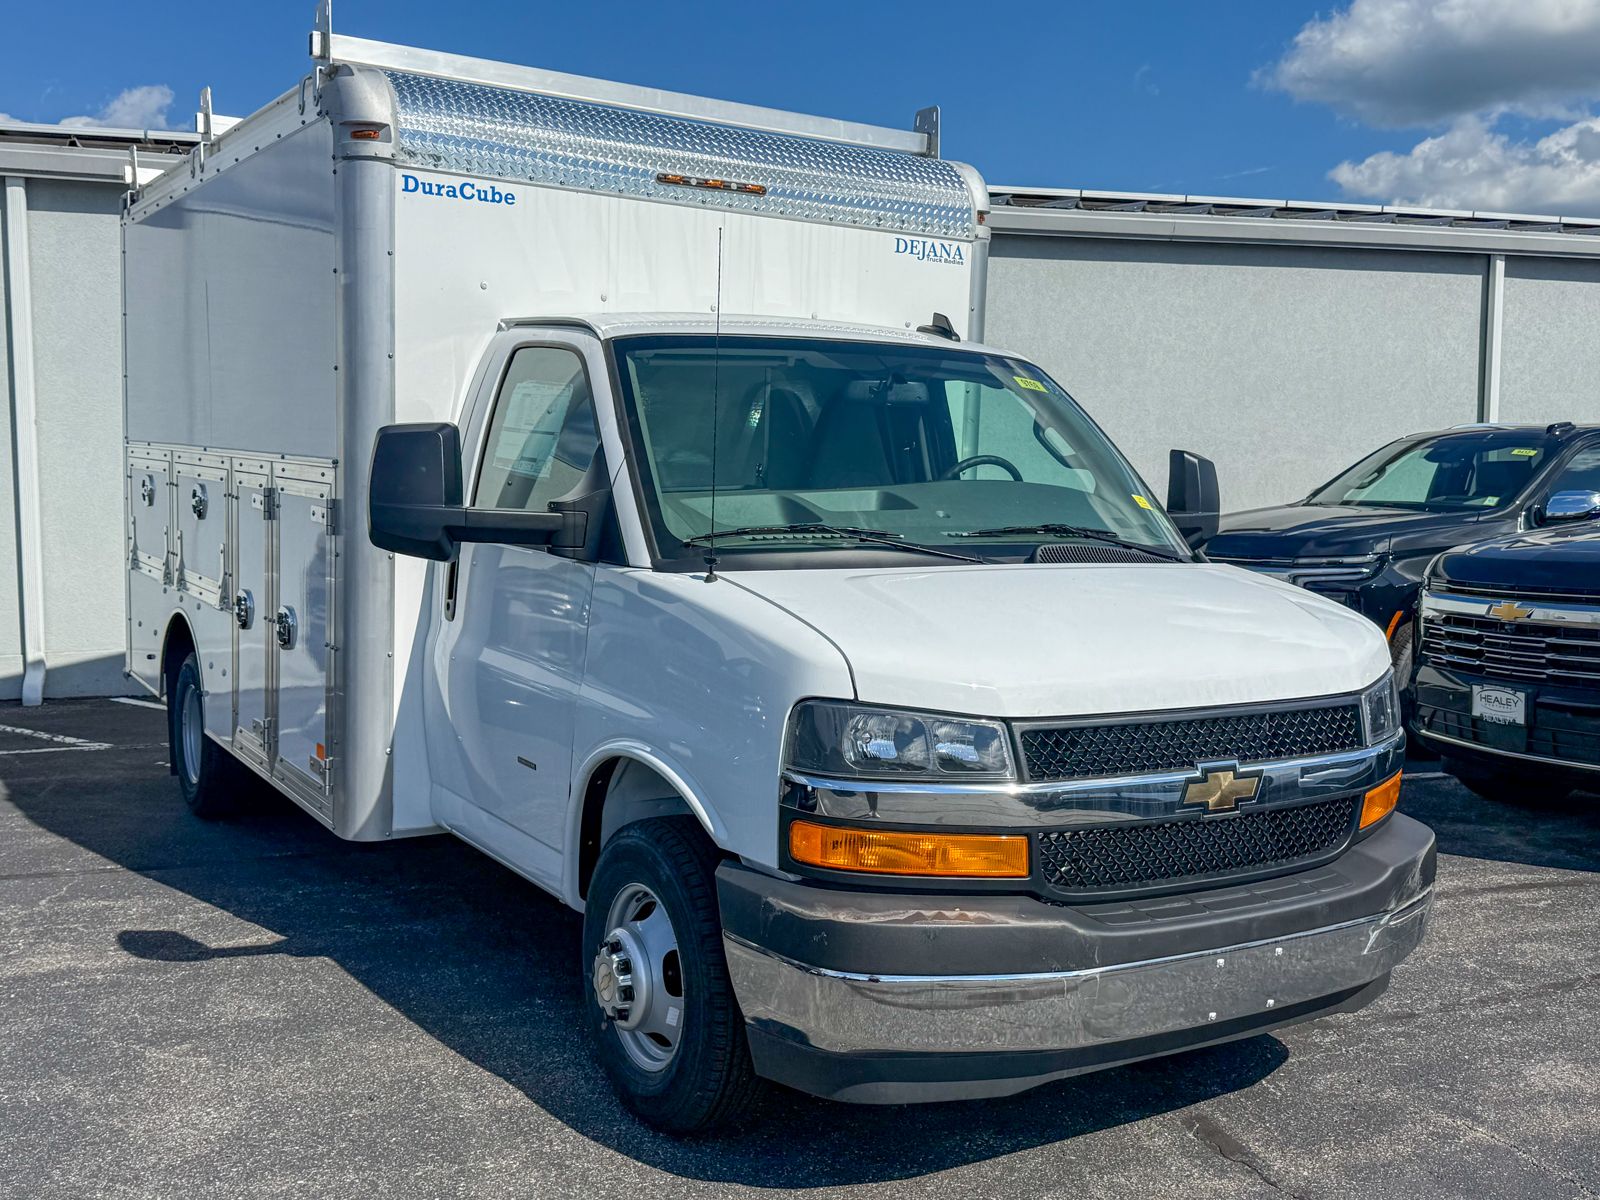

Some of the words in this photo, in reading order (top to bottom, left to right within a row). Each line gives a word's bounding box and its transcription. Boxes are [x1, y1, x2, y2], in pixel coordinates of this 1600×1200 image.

[402, 174, 516, 205] DuraCube
[895, 238, 964, 260] DEJANA
[1480, 694, 1519, 707] HEALEY
